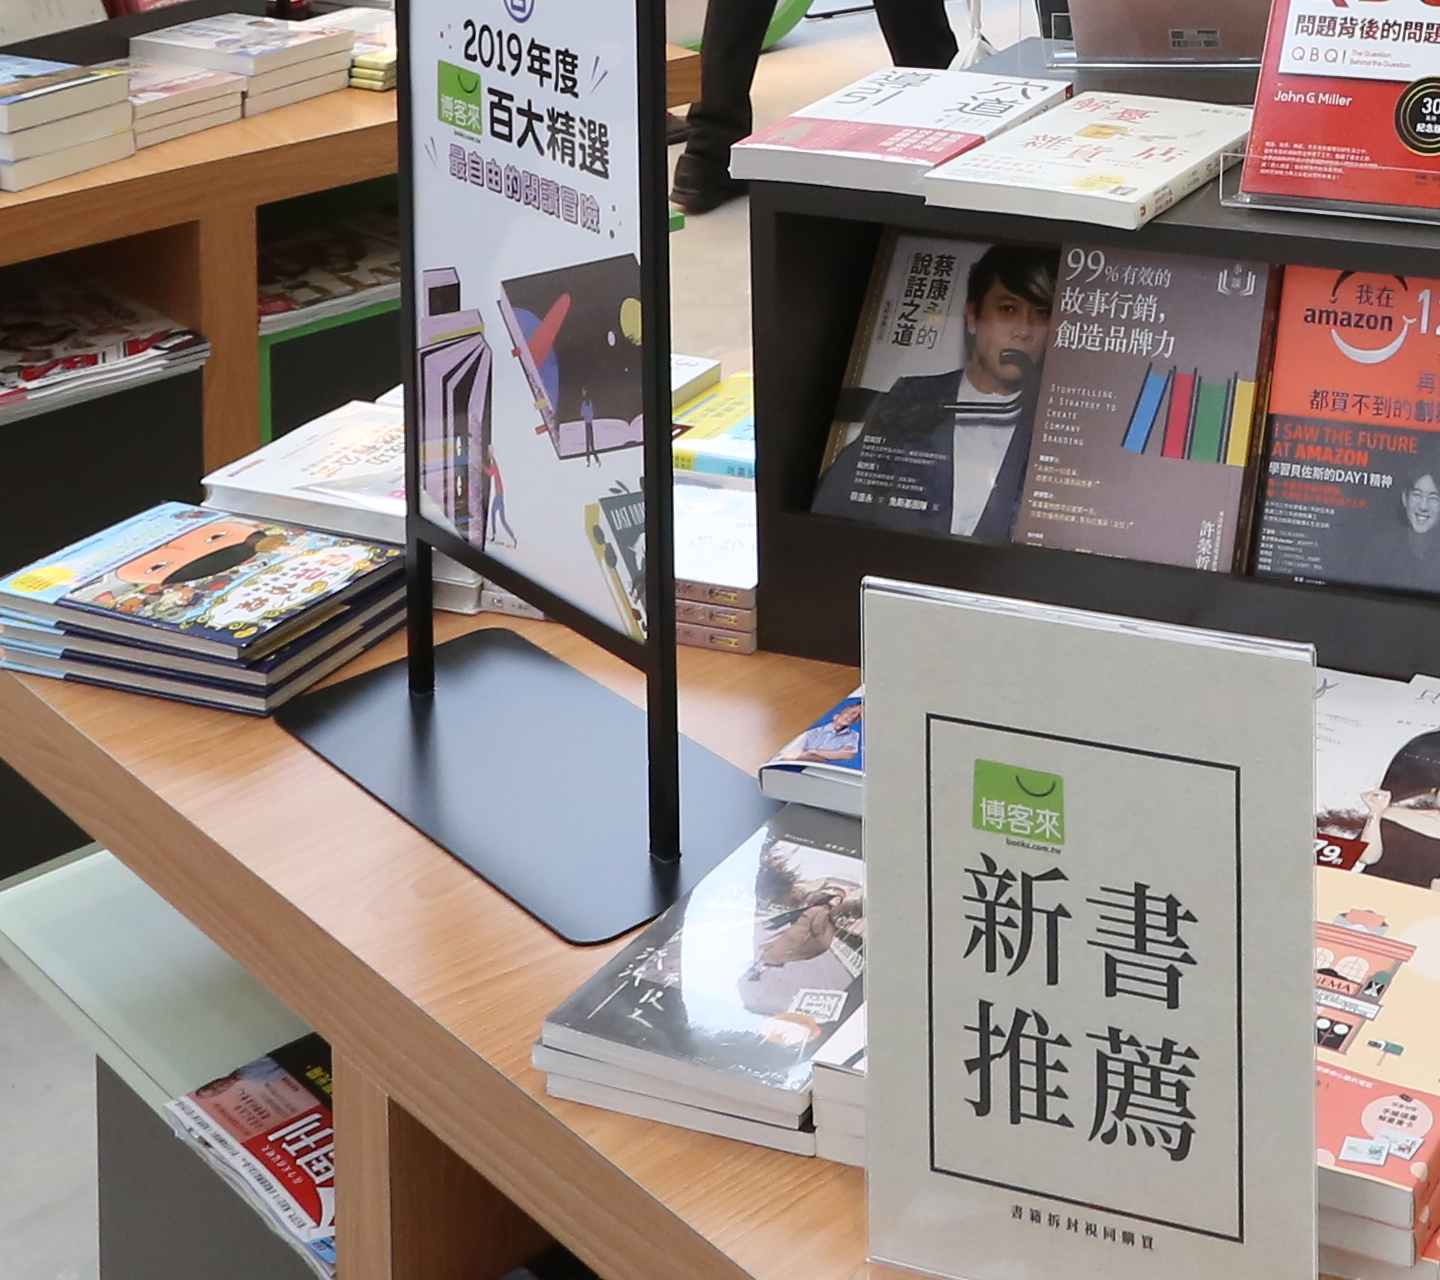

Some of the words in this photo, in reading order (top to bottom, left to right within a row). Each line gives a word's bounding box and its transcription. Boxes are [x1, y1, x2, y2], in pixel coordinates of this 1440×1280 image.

[462, 18, 581, 100] 2019年度
[439, 93, 482, 132] 博客來
[1070, 96, 1161, 124] 解憂
[1273, 88, 1303, 105] John
[1317, 92, 1354, 109] Miller
[487, 86, 611, 181] 百大精選
[1018, 132, 1192, 164] 雜貨店
[447, 142, 603, 235] 最自由的閱讀冒險
[1064, 247, 1173, 290] 99%有效的
[890, 250, 935, 348] 說話之道
[1355, 284, 1395, 309] 我在
[1303, 305, 1394, 332] amazon
[1052, 320, 1177, 361] 創造品牌力
[1271, 441, 1290, 458] AT
[1294, 444, 1370, 468] AMAZON
[1273, 422, 1280, 439] I
[1283, 424, 1320, 443] SAW
[1324, 427, 1353, 448] THE
[1356, 431, 1419, 455] FUTURE
[1268, 461, 1394, 490] 學習貝佐斯的DAY1精神
[979, 795, 1063, 841] 博客來
[1005, 836, 1063, 855] books.com.tw
[962, 851, 1200, 1010] 新書
[962, 1000, 1201, 1162] 推薦
[1010, 1203, 1156, 1253] 書籍拆封視同購買
